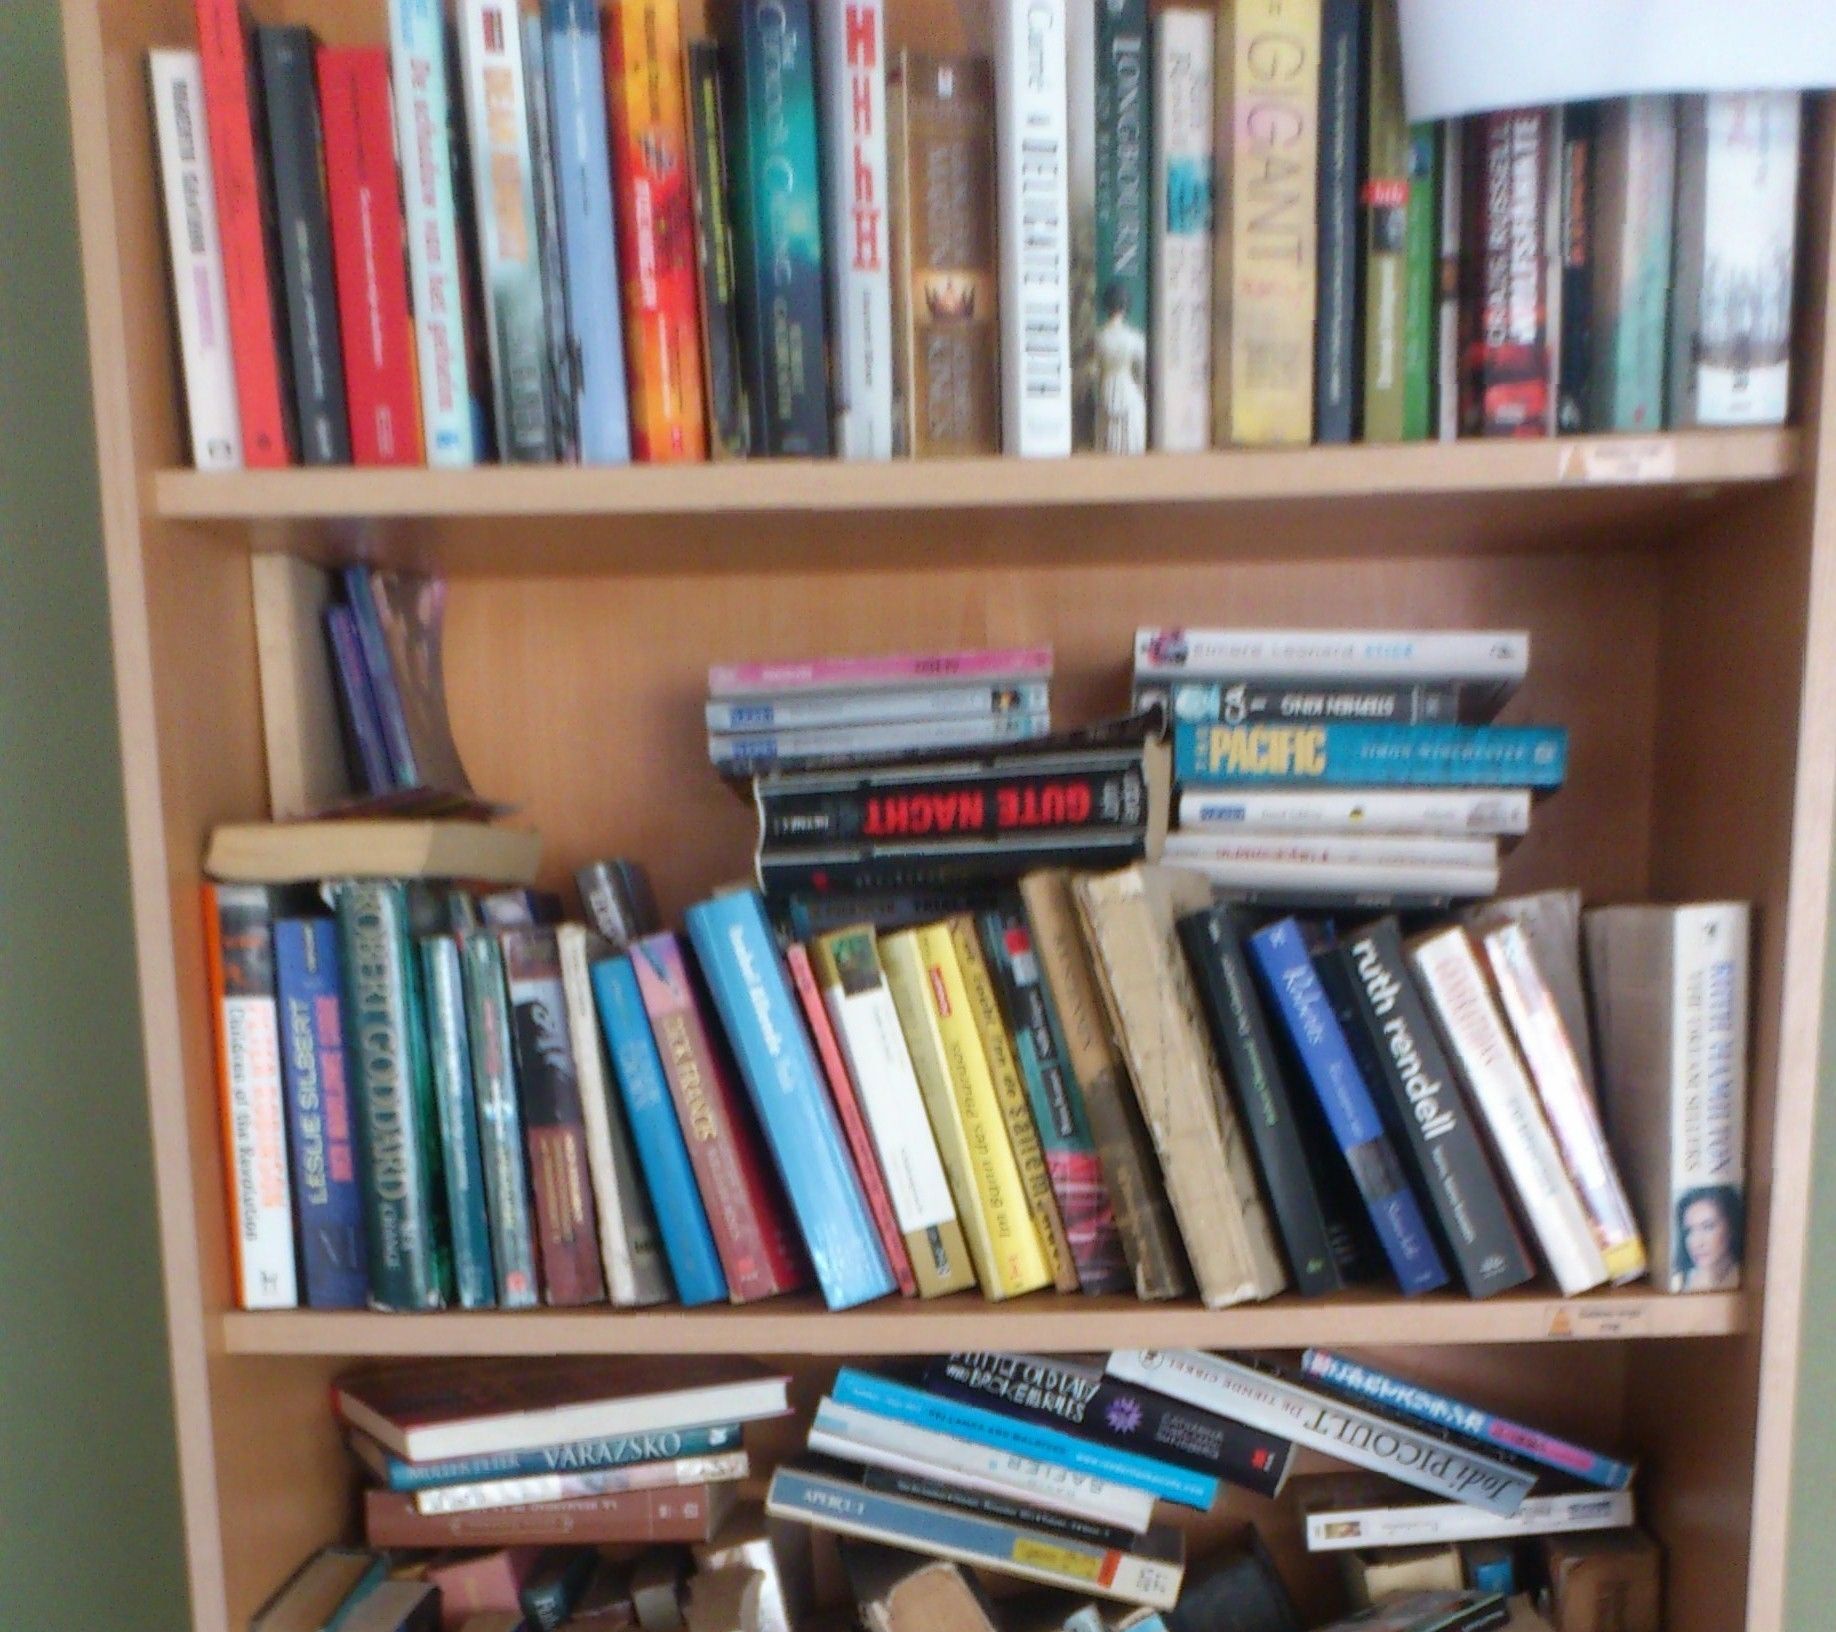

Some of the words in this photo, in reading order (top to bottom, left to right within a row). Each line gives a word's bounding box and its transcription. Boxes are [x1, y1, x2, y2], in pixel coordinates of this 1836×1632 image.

[1112, 37, 1141, 278] LONGBOURN
[1246, 31, 1306, 268] GIGANT
[1281, 694, 1322, 717] KING
[1325, 693, 1396, 717] STEPHEN
[1209, 726, 1327, 775] PACIFIC
[864, 790, 984, 836] NACHT
[997, 782, 1092, 825] GUTE
[349, 885, 398, 1014] ROBERT
[289, 996, 319, 1109] SILBERT
[1347, 935, 1409, 1018] ruth
[1381, 1015, 1460, 1140] rendell
[363, 1024, 408, 1201] GODDARD
[672, 1063, 718, 1143] FRANCIS
[297, 1115, 328, 1206] LESLIE
[968, 1369, 1027, 1405] BROKE
[1021, 1364, 1061, 1393] OLD
[1057, 1373, 1102, 1406] LADY
[1302, 1405, 1456, 1483] PICOULT
[1448, 1456, 1520, 1508] Jodi
